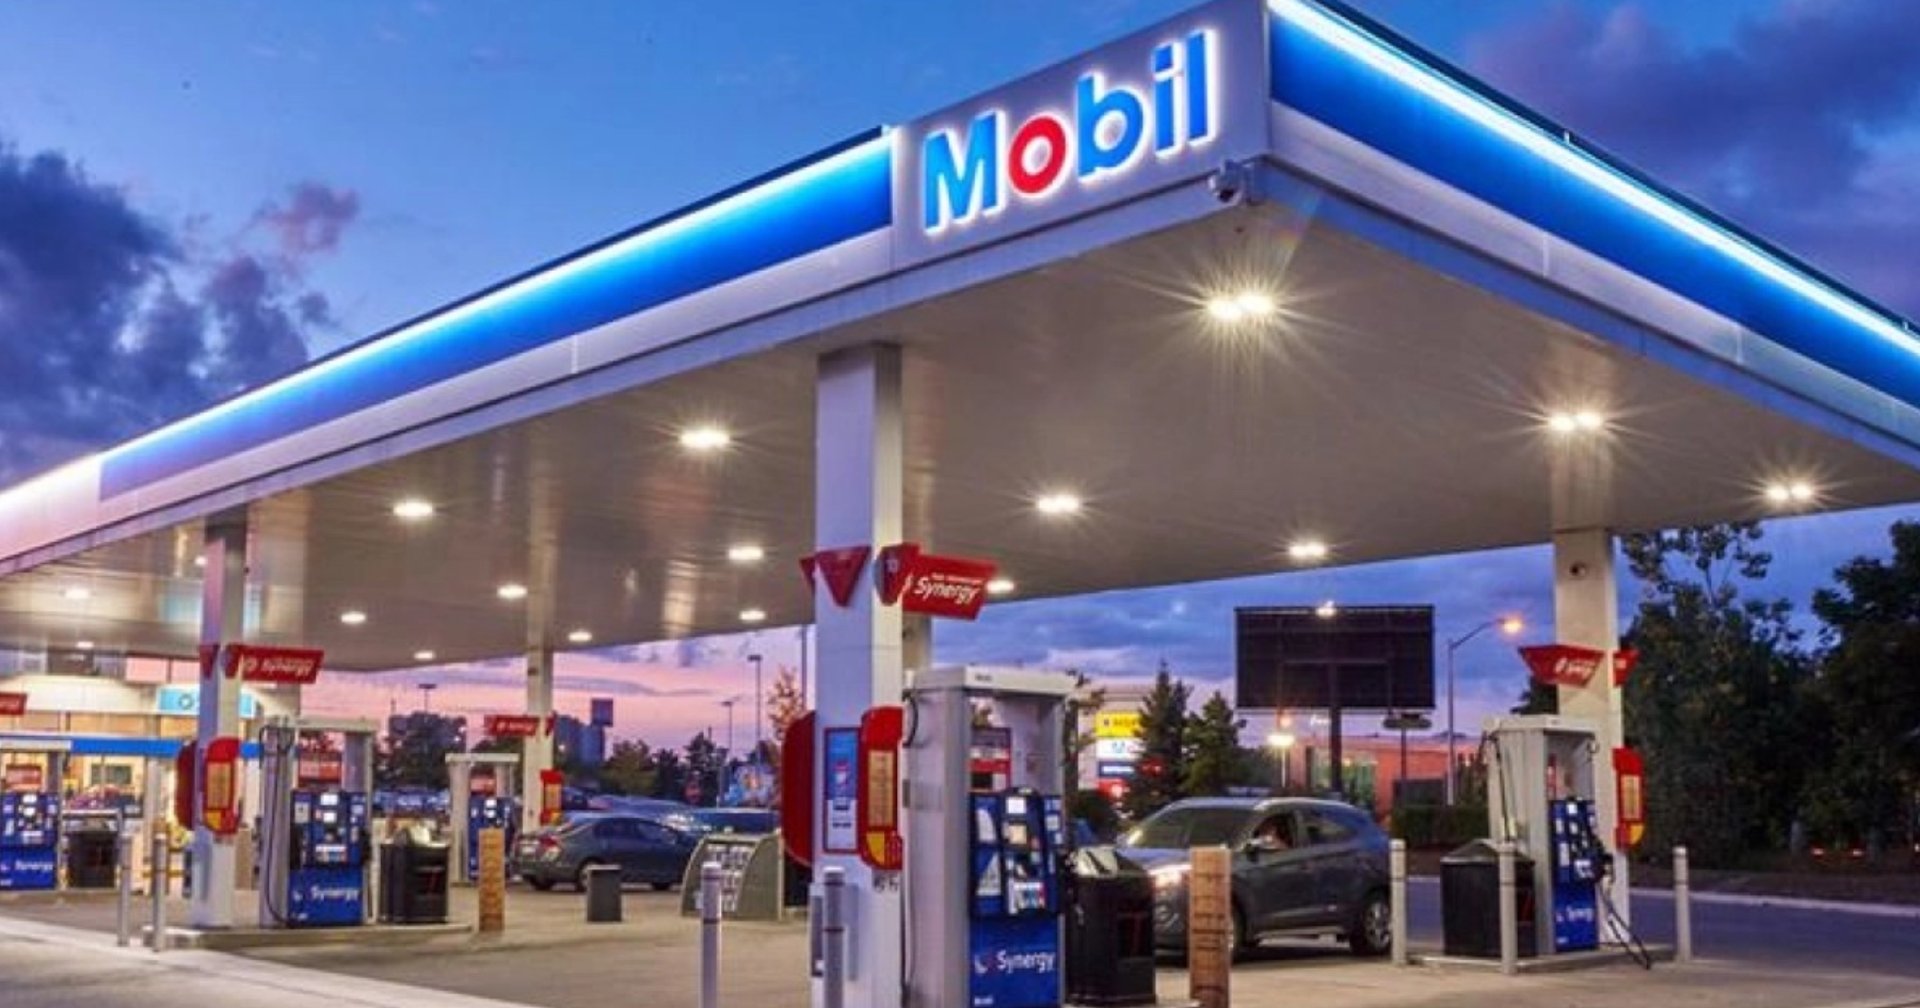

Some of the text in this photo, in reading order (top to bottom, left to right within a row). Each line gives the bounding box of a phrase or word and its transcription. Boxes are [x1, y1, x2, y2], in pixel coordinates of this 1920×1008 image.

[924, 30, 1213, 233] Mobil
[914, 576, 980, 605] Synergy
[996, 950, 1056, 974] Synergy
